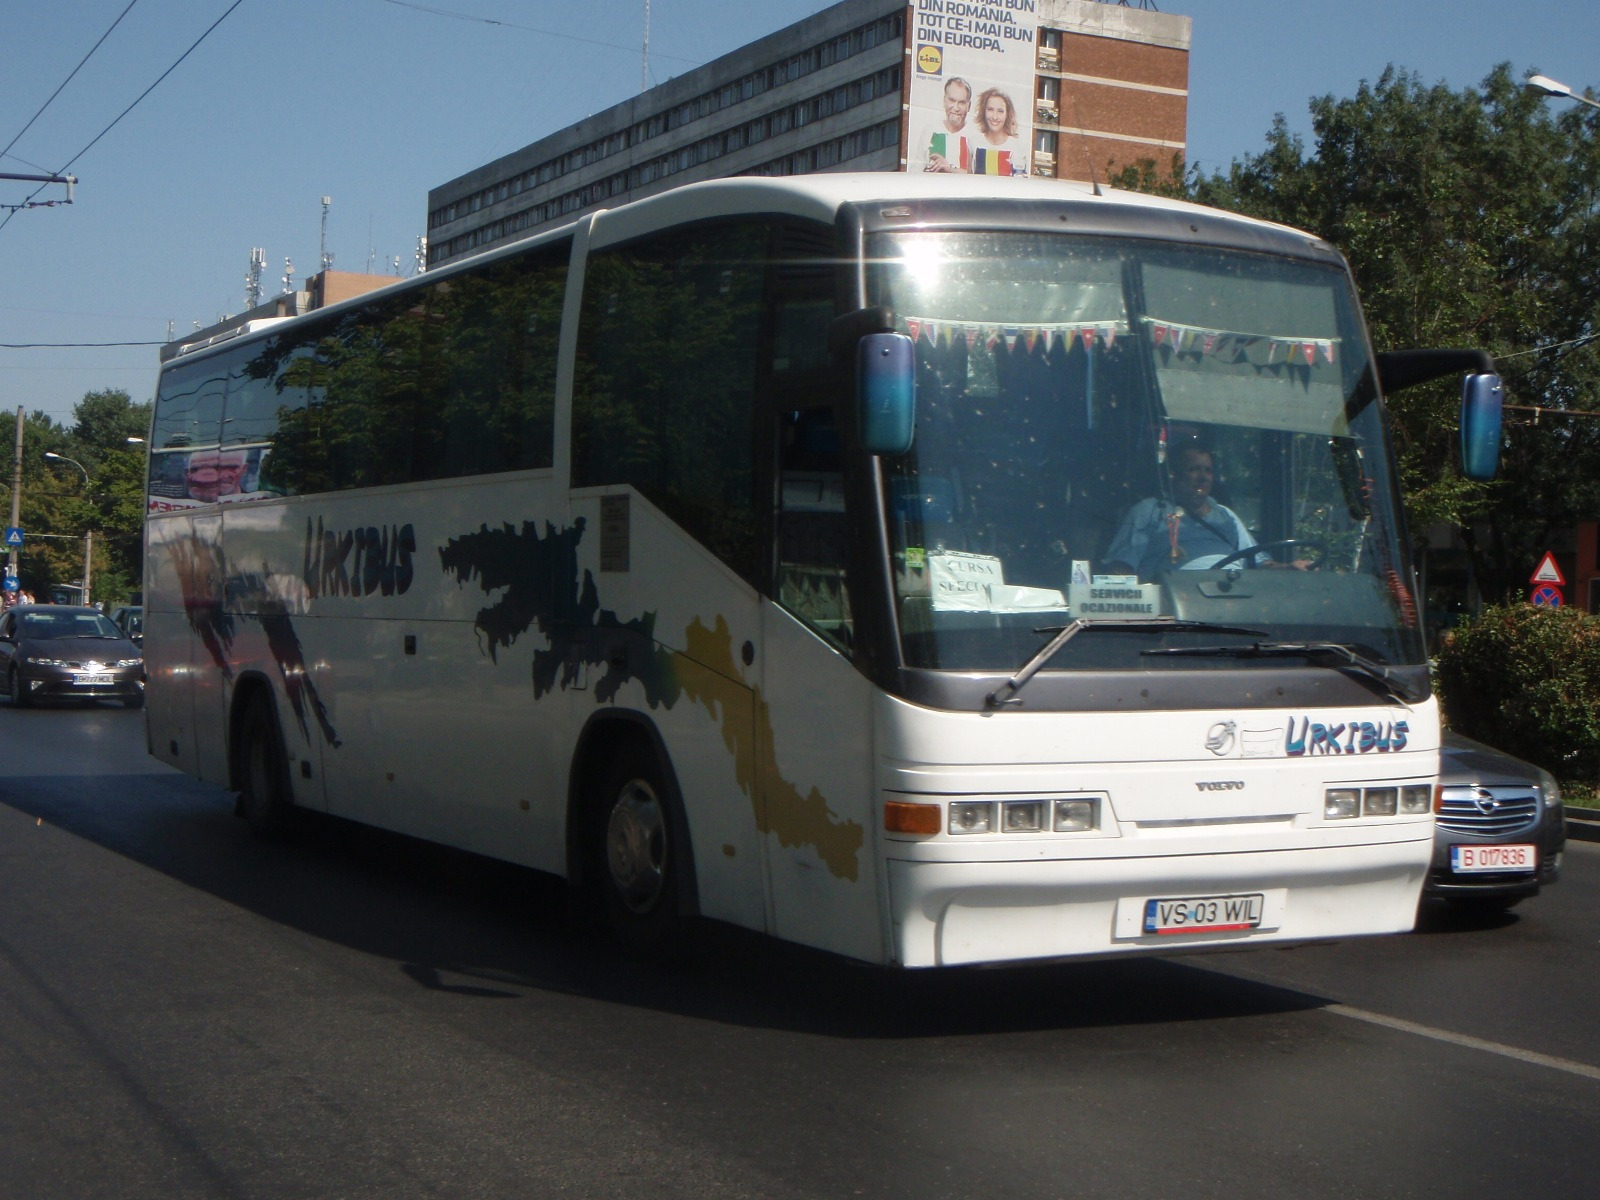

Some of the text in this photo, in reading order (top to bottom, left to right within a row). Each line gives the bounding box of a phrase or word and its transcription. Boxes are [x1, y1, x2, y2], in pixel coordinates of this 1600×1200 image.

[918, 0, 1017, 25] DIN ROMÂNIA.
[1005, 0, 1035, 13] BUN
[918, 12, 1033, 42] TOT CE-I MAI BUN
[917, 28, 1005, 53] DIN EUROPA.
[303, 514, 417, 600] URKIBUS
[1090, 588, 1142, 599] SERVICII
[1081, 602, 1153, 613] OCAZIONALE
[1285, 715, 1410, 757] URKIBUS
[1195, 780, 1245, 792] VOLVO
[1464, 848, 1526, 867] B 017836
[1160, 899, 1258, 926] VS 03 WIL
